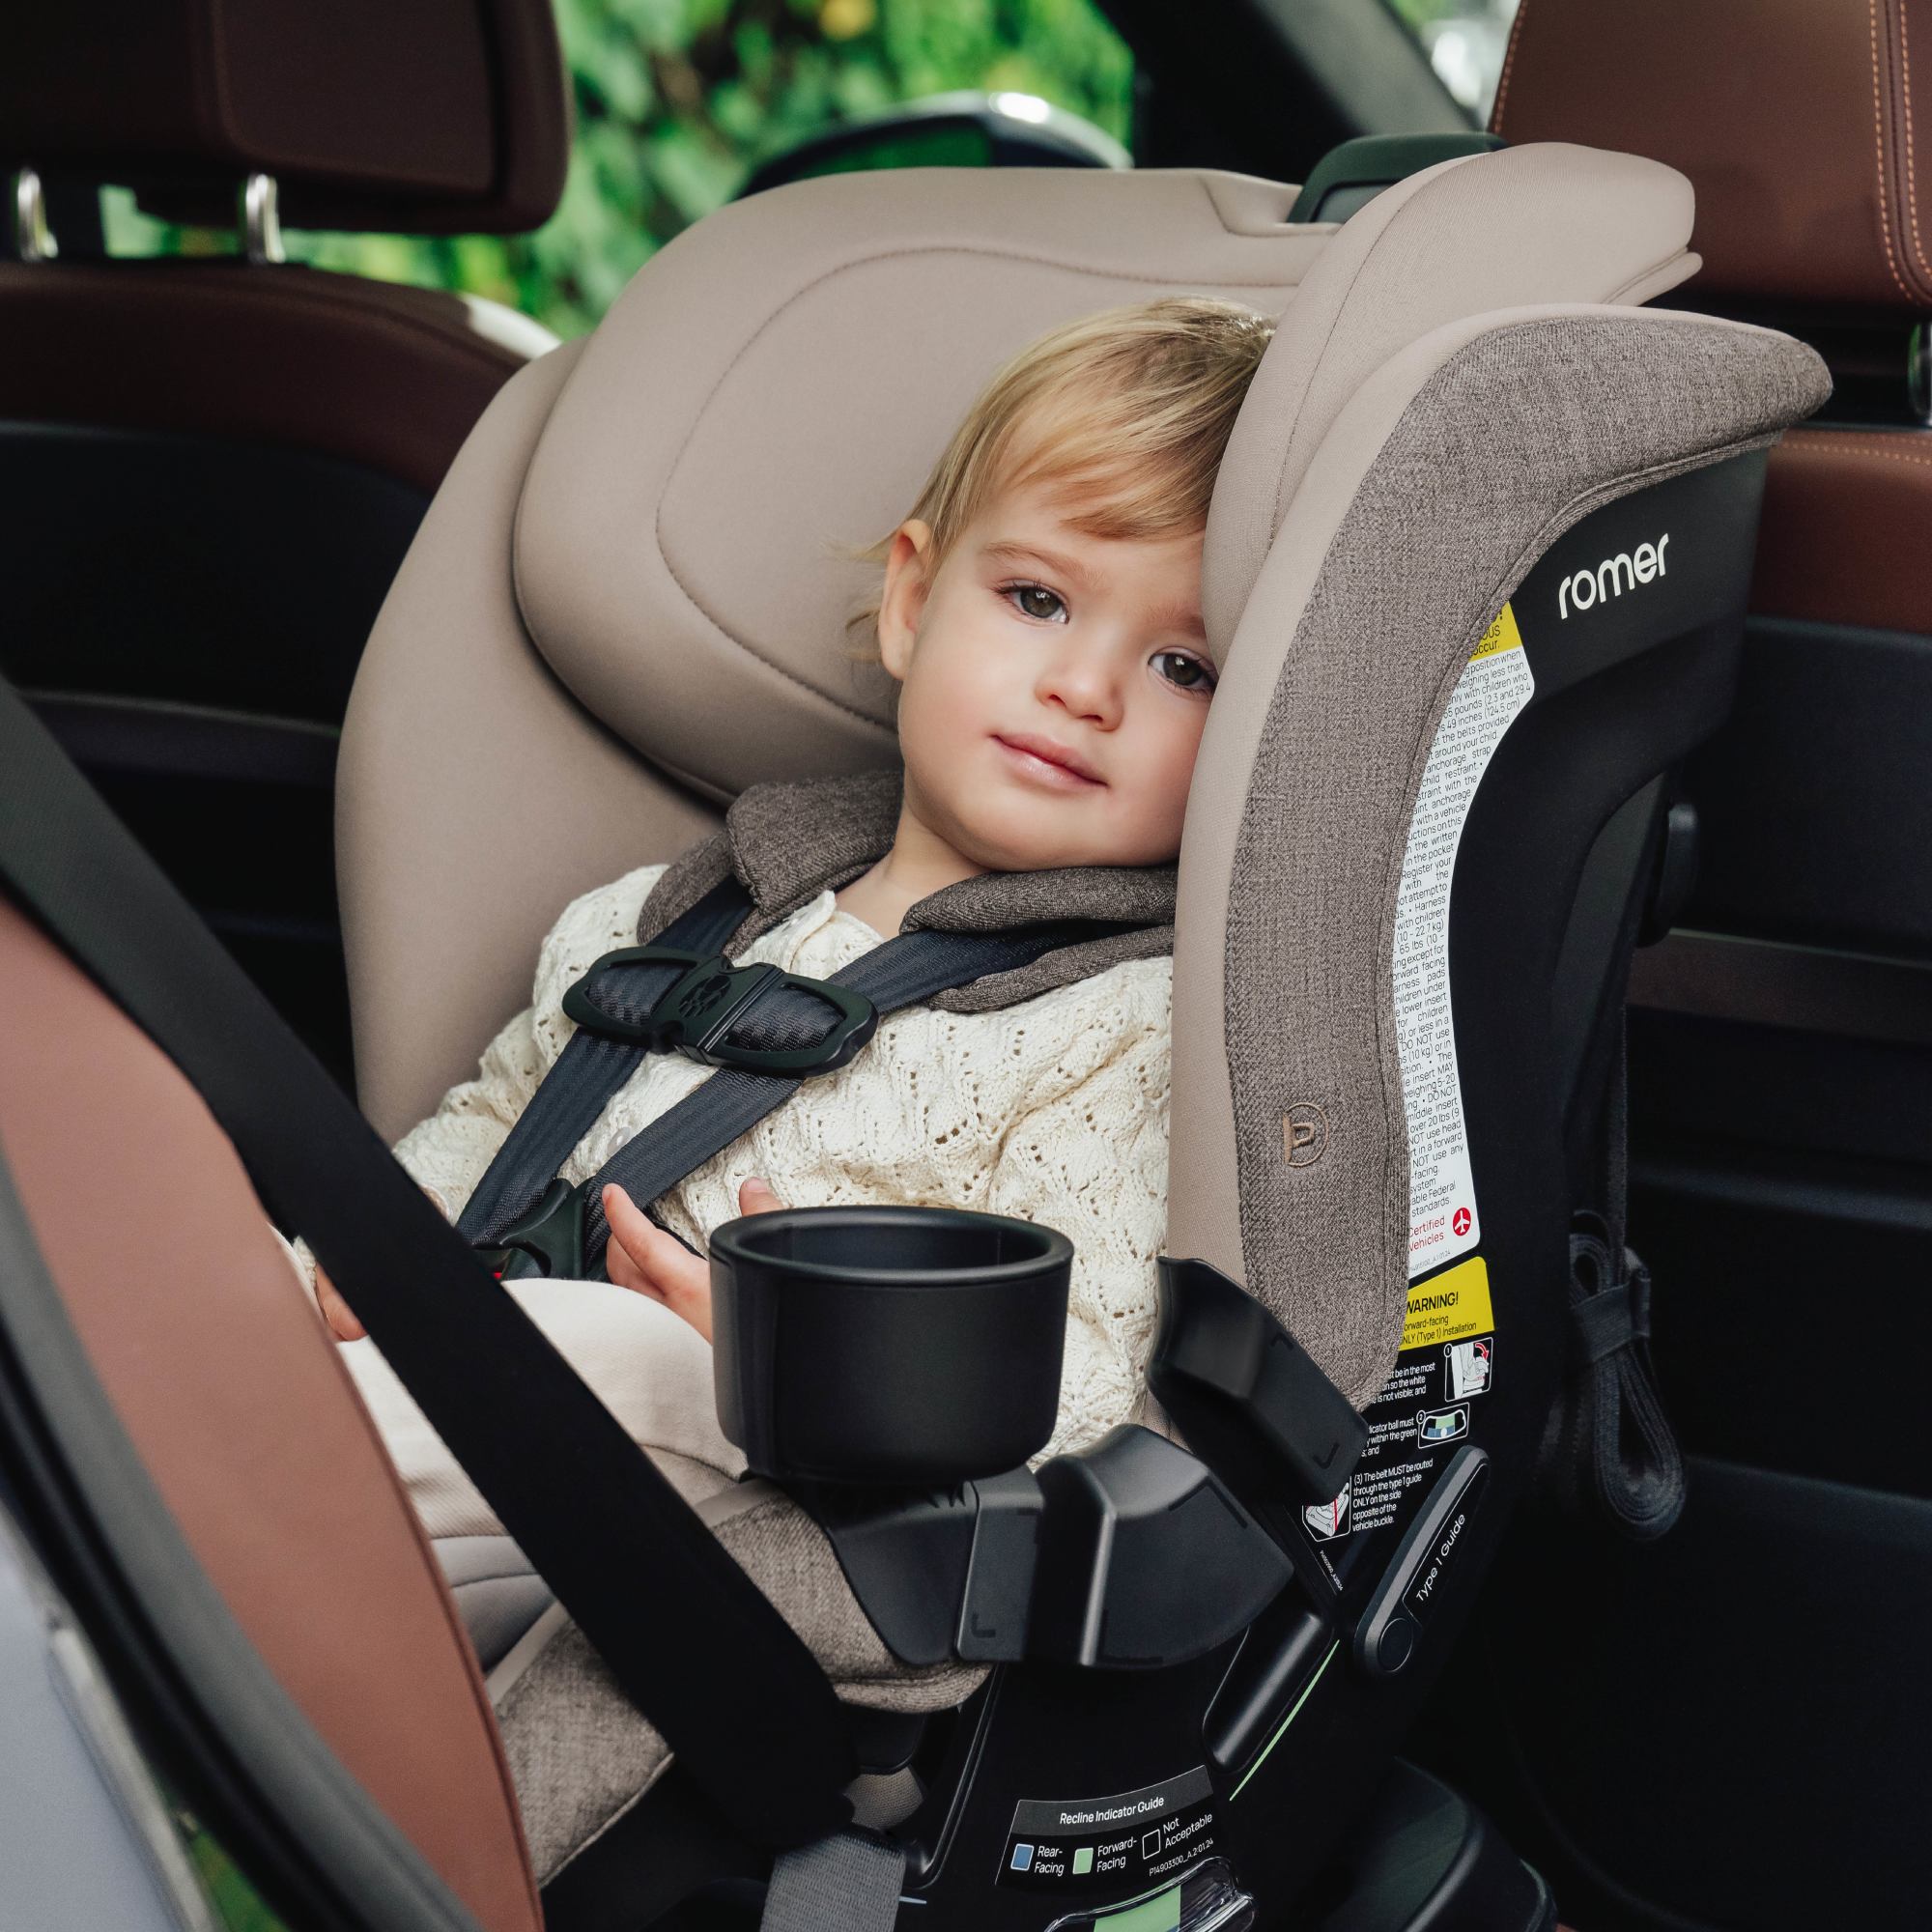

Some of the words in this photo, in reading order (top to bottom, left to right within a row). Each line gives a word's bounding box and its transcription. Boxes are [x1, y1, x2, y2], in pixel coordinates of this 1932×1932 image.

[1559, 533, 1669, 619] romer
[1470, 657, 1501, 675] position
[1501, 651, 1520, 663] when
[1492, 668, 1505, 678] less
[1508, 662, 1523, 672] than
[1464, 689, 1481, 699] with
[1482, 678, 1511, 694] children
[1513, 672, 1528, 683] who
[1455, 699, 1482, 715] pounds
[1499, 688, 1514, 697] and
[1516, 684, 1530, 694] 29.4
[1447, 718, 1456, 728] 49
[1459, 710, 1482, 725] inches
[1506, 699, 1520, 710] cm)
[1442, 733, 1455, 744] the
[1458, 725, 1476, 739] belts
[1478, 716, 1509, 733] provided
[1435, 745, 1461, 758] around
[1463, 738, 1478, 751] your
[1427, 753, 1466, 773] anchorage
[1472, 747, 1491, 758] strap
[1418, 786, 1441, 801] straint
[1445, 781, 1462, 791] with
[1465, 775, 1477, 784] the
[1422, 775, 1439, 786] child
[1432, 789, 1470, 809] anchorage
[1416, 812, 1433, 826] with
[1440, 803, 1465, 817] vehicle
[1437, 821, 1447, 831] on
[1448, 815, 1462, 827] this
[1415, 840, 1428, 849] the
[1432, 831, 1457, 845] written
[1406, 857, 1412, 867] in
[1414, 853, 1427, 864] the
[1429, 843, 1454, 861] pocket
[1435, 857, 1451, 870] your
[1406, 880, 1421, 891] with
[1436, 870, 1448, 880] the
[1409, 887, 1437, 902] attempt
[1439, 882, 1447, 891] to
[1415, 895, 1445, 912] Harness
[1397, 918, 1413, 930] with
[1415, 908, 1445, 925] children
[1407, 948, 1433, 963] except
[1435, 945, 1444, 954] for
[1412, 939, 1423, 950] lbs
[1393, 965, 1418, 982] orward
[1422, 956, 1445, 970] facing
[1395, 978, 1420, 994] arness
[1428, 969, 1445, 983] pads
[1396, 988, 1422, 1005] hildren
[1424, 980, 1445, 995] under
[1403, 1001, 1422, 1014] lower
[1425, 992, 1446, 1007] insert
[1398, 1018, 1407, 1028] for
[1418, 1005, 1447, 1021] children
[1418, 1021, 1434, 1034] less
[1402, 1039, 1413, 1051] DO
[1417, 1033, 1433, 1046] NOT
[1436, 1028, 1449, 1039] use
[1437, 1051, 1452, 1062] The
[1413, 1069, 1435, 1084] insert
[1437, 1062, 1453, 1074] MAY
[1428, 1090, 1439, 1102] DO
[1440, 1085, 1456, 1098] NOT
[1407, 1106, 1433, 1122] middle
[1435, 1097, 1458, 1112] insert
[1410, 1122, 1427, 1133] over
[1428, 1116, 1437, 1127] 20
[1438, 1113, 1450, 1122] lbs
[1426, 1128, 1440, 1139] use
[1442, 1121, 1461, 1132] head
[1419, 1145, 1426, 1153] in
[1434, 1132, 1462, 1149] forward
[1413, 1155, 1430, 1168] NOT
[1433, 1150, 1446, 1161] use
[1451, 1144, 1463, 1154] any
[1429, 1180, 1456, 1198] Federal
[1405, 1315, 1448, 1332] orward-facing
[1403, 1335, 1415, 1345] NLY
[1417, 1332, 1435, 1345] (Type
[1395, 1369, 1403, 1378] be
[1404, 1367, 1409, 1376] in
[1409, 1365, 1420, 1375] the
[1420, 1362, 1435, 1373] most
[1399, 1378, 1409, 1387] the
[1409, 1375, 1425, 1385] white
[1383, 1391, 1394, 1401] not
[1415, 1385, 1426, 1395] and
[1369, 1421, 1388, 1434] icator
[1388, 1420, 1399, 1431] ball
[1400, 1418, 1414, 1427] must
[1371, 1432, 1388, 1444] within
[1389, 1431, 1400, 1439] the
[1401, 1428, 1417, 1439] green
[1368, 1446, 1379, 1456] and
[1354, 1473, 1363, 1486] (3)
[1364, 1472, 1376, 1482] The
[1376, 1469, 1387, 1479] belt
[1388, 1464, 1406, 1477] MUST
[1406, 1463, 1413, 1473] be
[1414, 1459, 1433, 1471] routed
[1353, 1483, 1377, 1497] through
[1378, 1482, 1388, 1492] the
[1389, 1479, 1402, 1491] type
[1406, 1473, 1422, 1487] guide
[1353, 1497, 1371, 1508] ONLY
[1371, 1496, 1378, 1505] on
[1378, 1494, 1388, 1503] the
[1388, 1491, 1402, 1501] side
[1353, 1507, 1379, 1521] opposite
[1380, 1506, 1386, 1515] of
[1386, 1503, 1396, 1513] the
[1352, 1520, 1374, 1532] vehicle
[1416, 1568, 1437, 1601] Type
[1441, 1515, 1465, 1556] Guide
[1061, 1810, 1094, 1825] Recline
[1095, 1805, 1136, 1822] Indicator
[1138, 1797, 1164, 1812] Guide
[1163, 1817, 1179, 1833] Not
[1165, 1813, 1212, 1849] Acceptable
[1037, 1846, 1063, 1858] Rear-
[1097, 1837, 1138, 1857] Forward-
[1035, 1861, 1064, 1876] Facing
[1097, 1856, 1125, 1872] Facing
